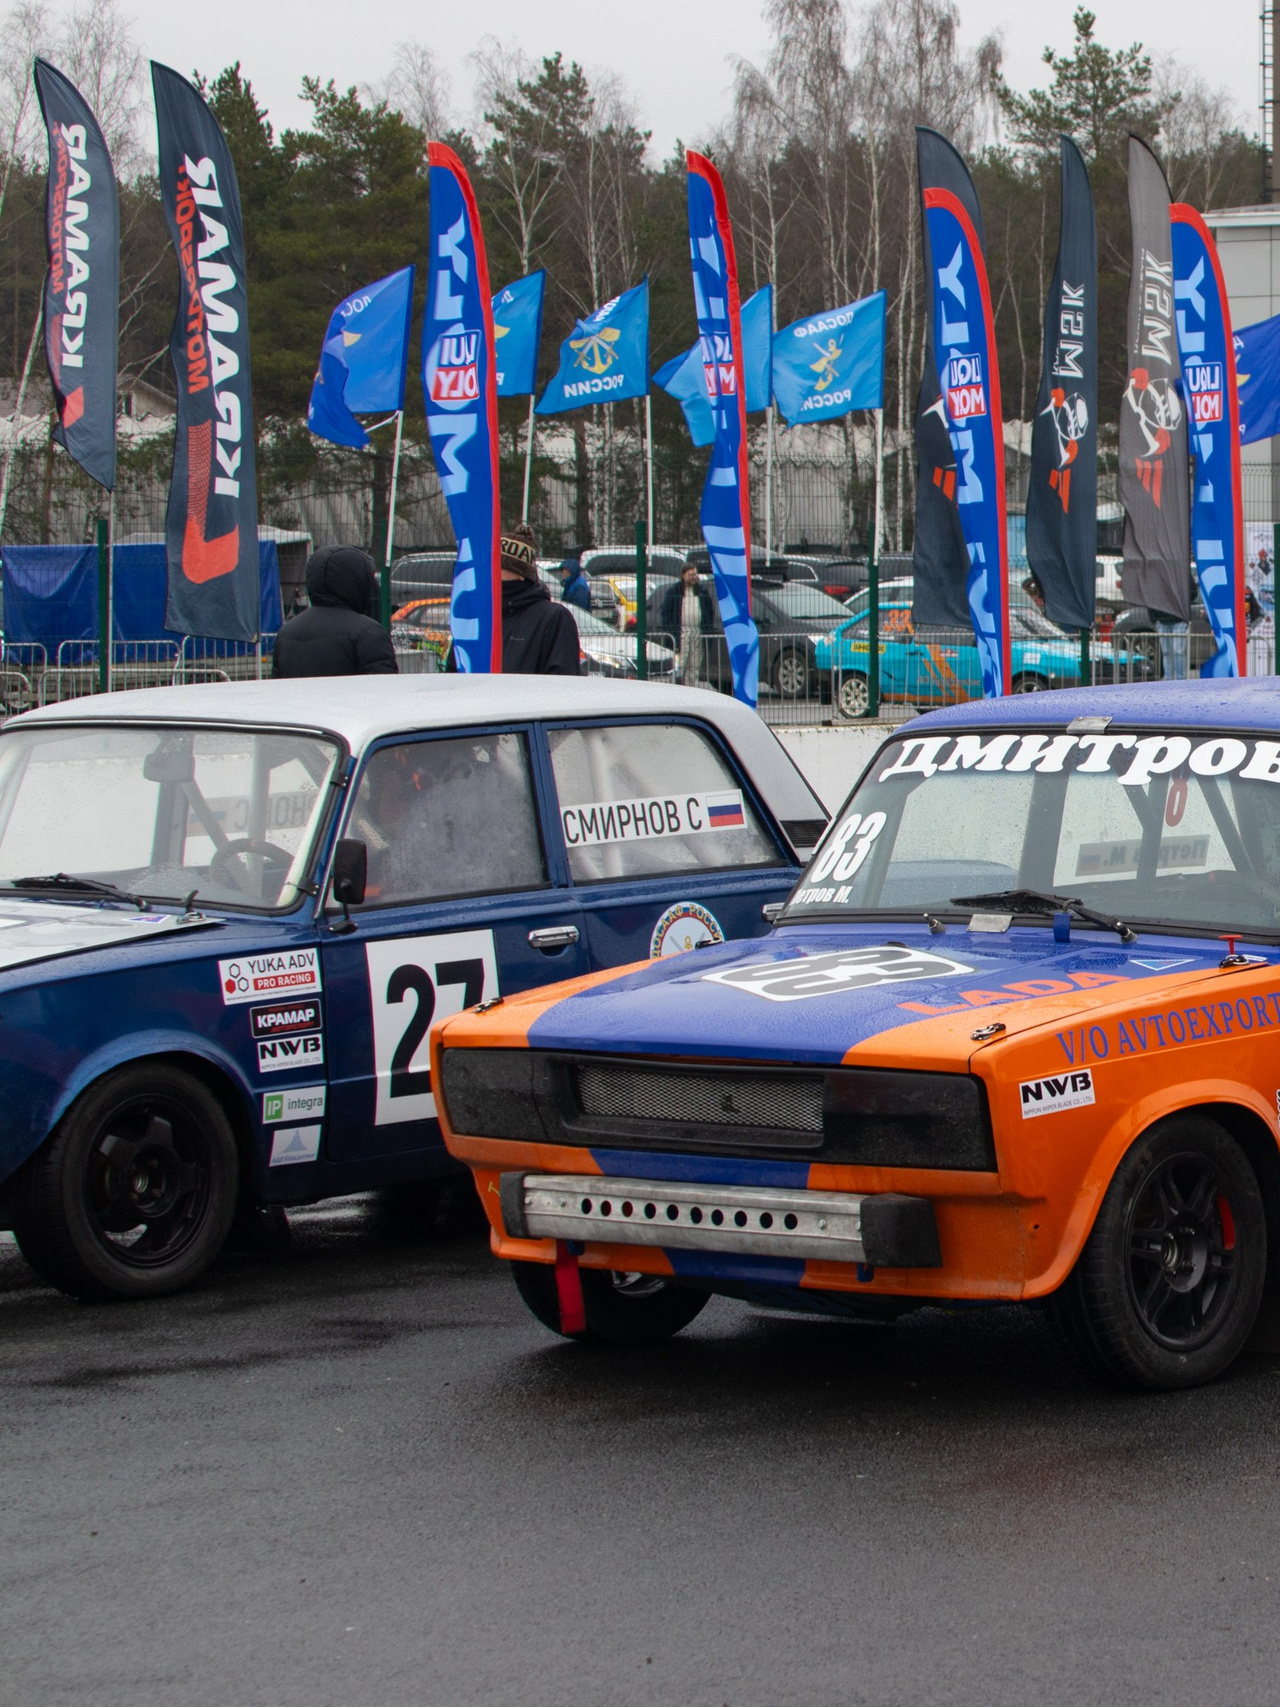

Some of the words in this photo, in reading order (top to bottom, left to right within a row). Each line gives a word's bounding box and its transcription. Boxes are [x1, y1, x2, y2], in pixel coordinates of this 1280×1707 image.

[563, 800, 681, 844] СМИРНОВ
[686, 797, 702, 831] С
[811, 811, 886, 883] 83
[248, 957, 286, 974] YUKA
[289, 952, 315, 969] ADV
[257, 978, 276, 989] PRO
[278, 973, 311, 986] RACING
[897, 971, 1132, 1015] LADA
[257, 1008, 315, 1028] КРАМАР
[386, 958, 485, 1100] 27
[260, 1037, 321, 1059] NWB
[1021, 1072, 1091, 1104] NWB
[268, 1101, 281, 1116] IP
[288, 1097, 323, 1111] integra
[1042, 1103, 1057, 1111] WIPER
[1057, 1100, 1072, 1109] BLADE
